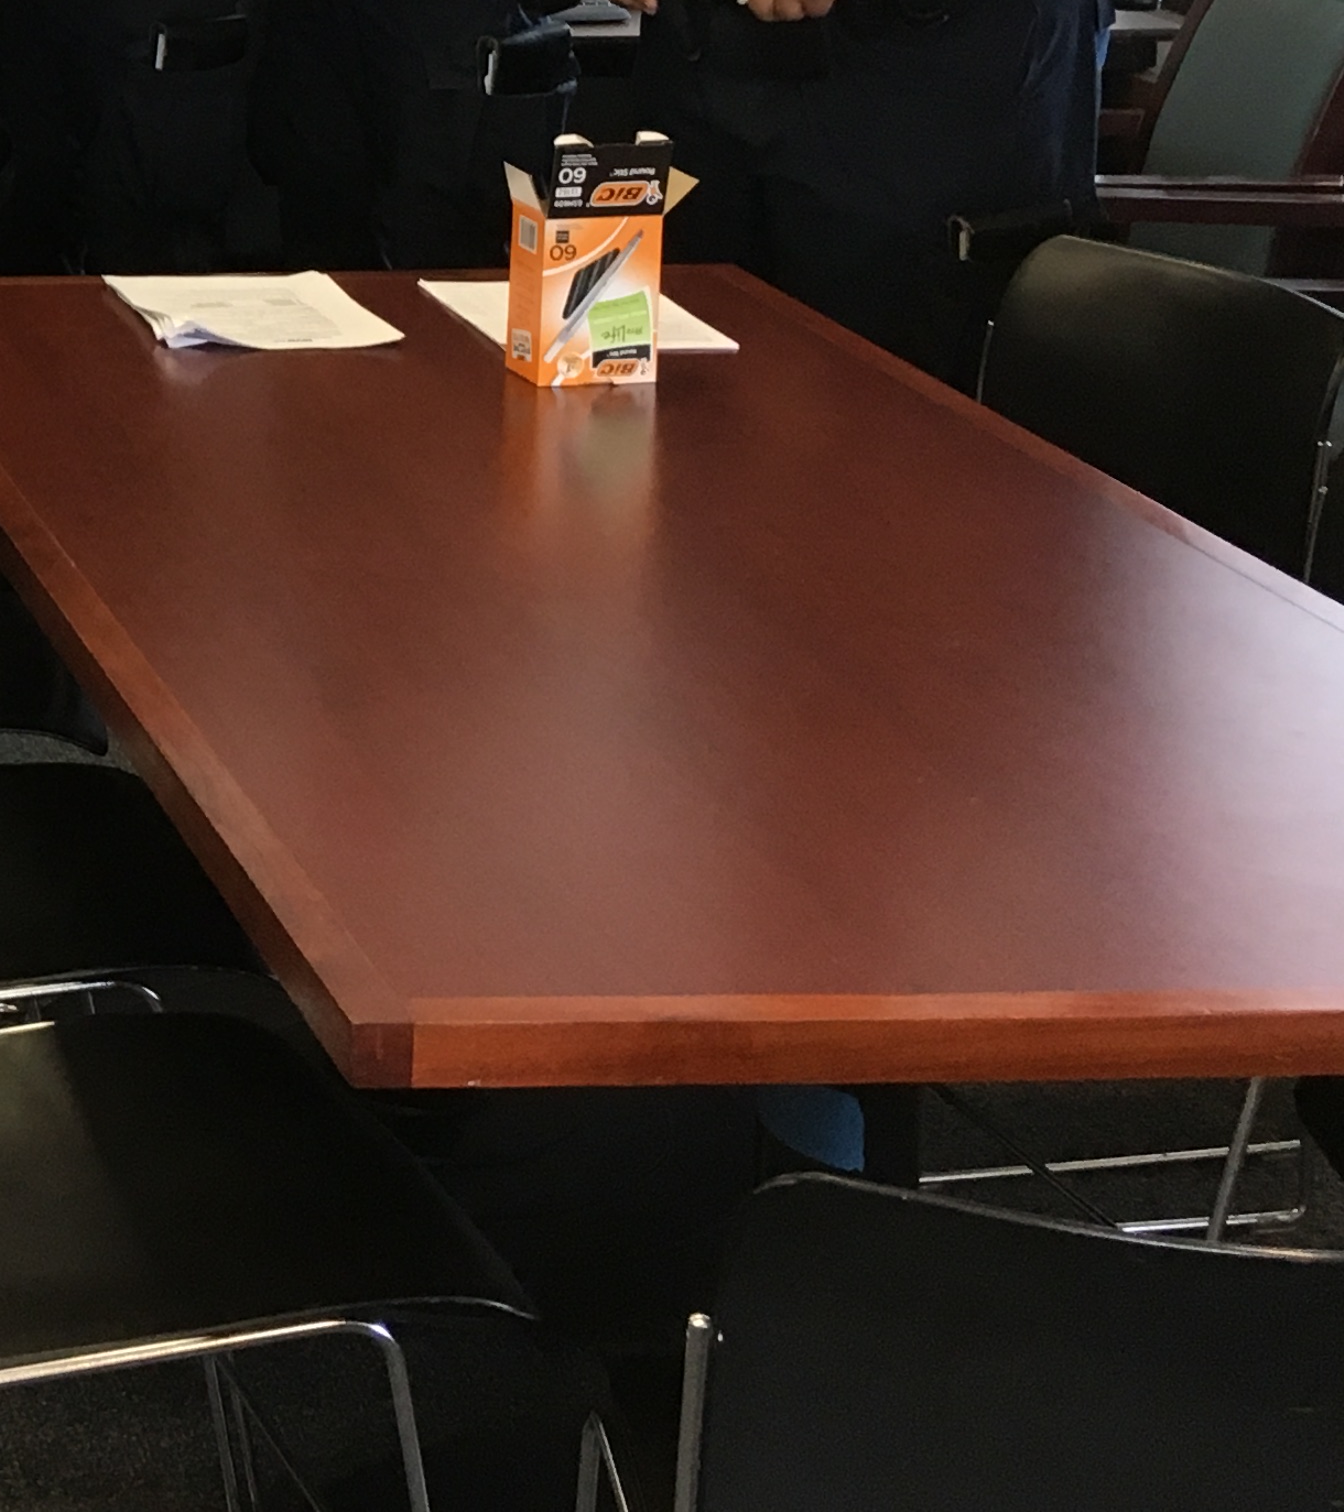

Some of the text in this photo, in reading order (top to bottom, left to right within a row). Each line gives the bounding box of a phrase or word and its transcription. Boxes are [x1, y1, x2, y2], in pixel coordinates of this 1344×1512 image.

[558, 167, 587, 184] 60
[613, 167, 656, 177] Round Stic
[596, 187, 642, 202] BIC
[549, 244, 577, 262] 60
[600, 363, 635, 375] BIC
